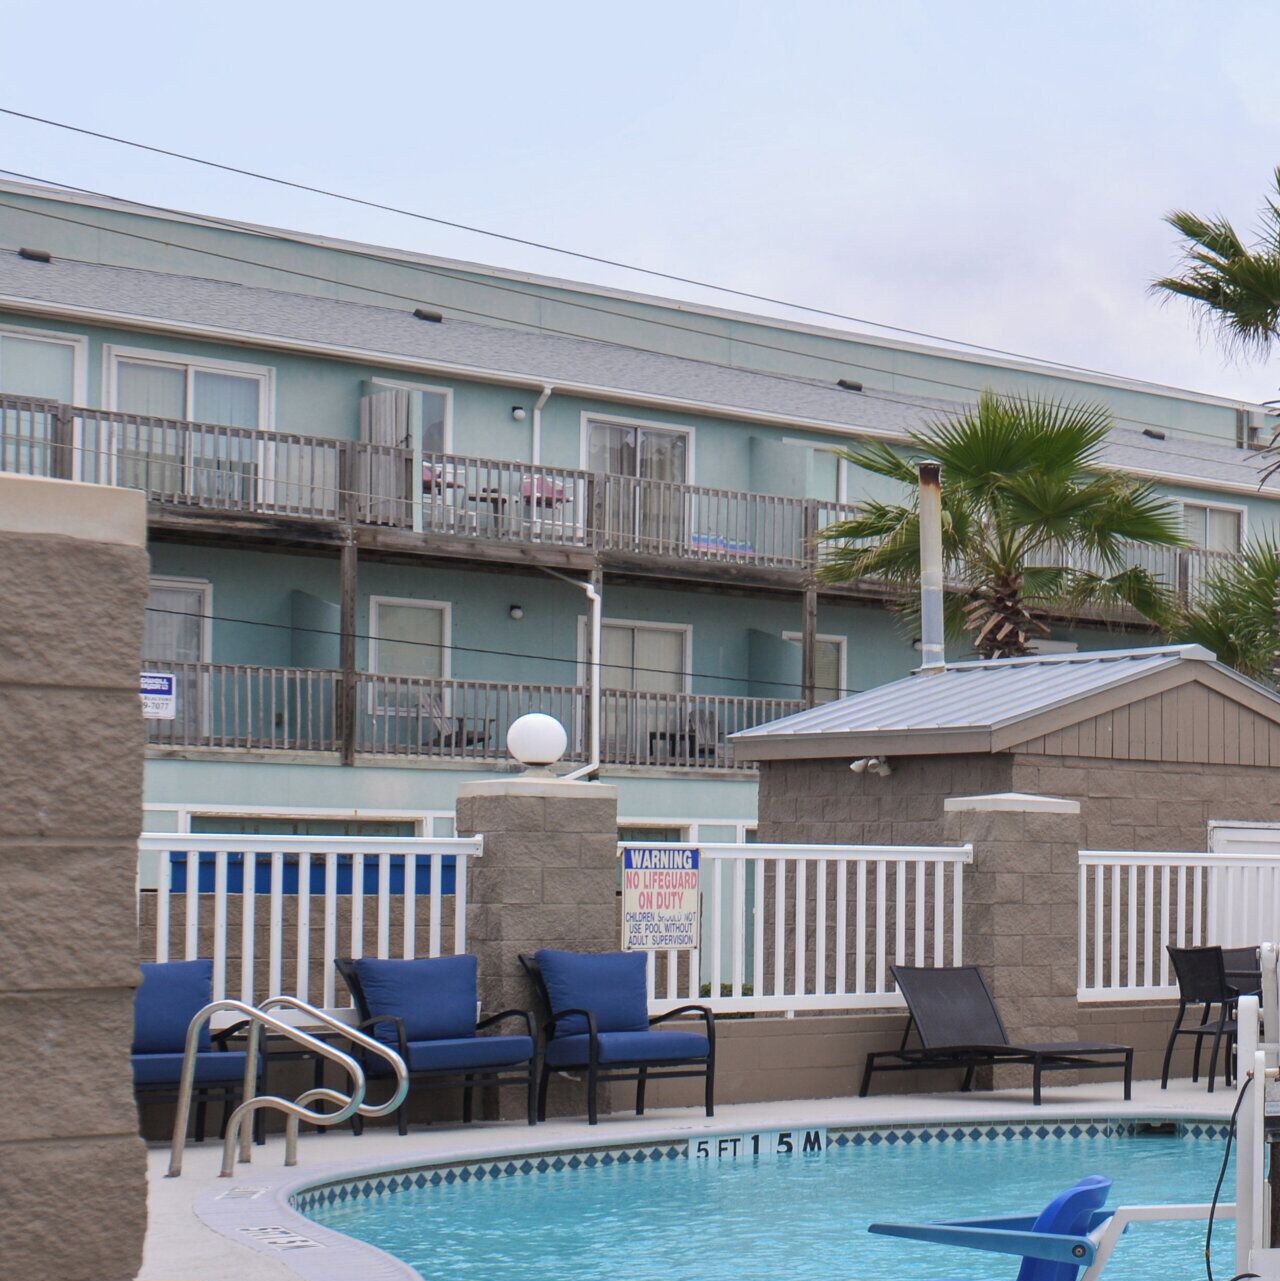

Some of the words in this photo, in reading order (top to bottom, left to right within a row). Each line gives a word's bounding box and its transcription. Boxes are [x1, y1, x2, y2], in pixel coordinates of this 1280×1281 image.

[631, 850, 693, 869] WARNING
[626, 871, 640, 889] NO
[643, 871, 697, 889] LIFEGUARD
[638, 892, 653, 910] ON
[656, 892, 683, 910] DUTY
[626, 912, 655, 922] CHILDREN
[629, 923, 642, 934] USE
[645, 923, 662, 934] POOL
[665, 923, 692, 933] WITHOUT
[628, 935, 648, 945] ADULT
[652, 935, 693, 945] SUPERVISION
[696, 1141, 709, 1158] 5
[802, 1130, 822, 1152] M
